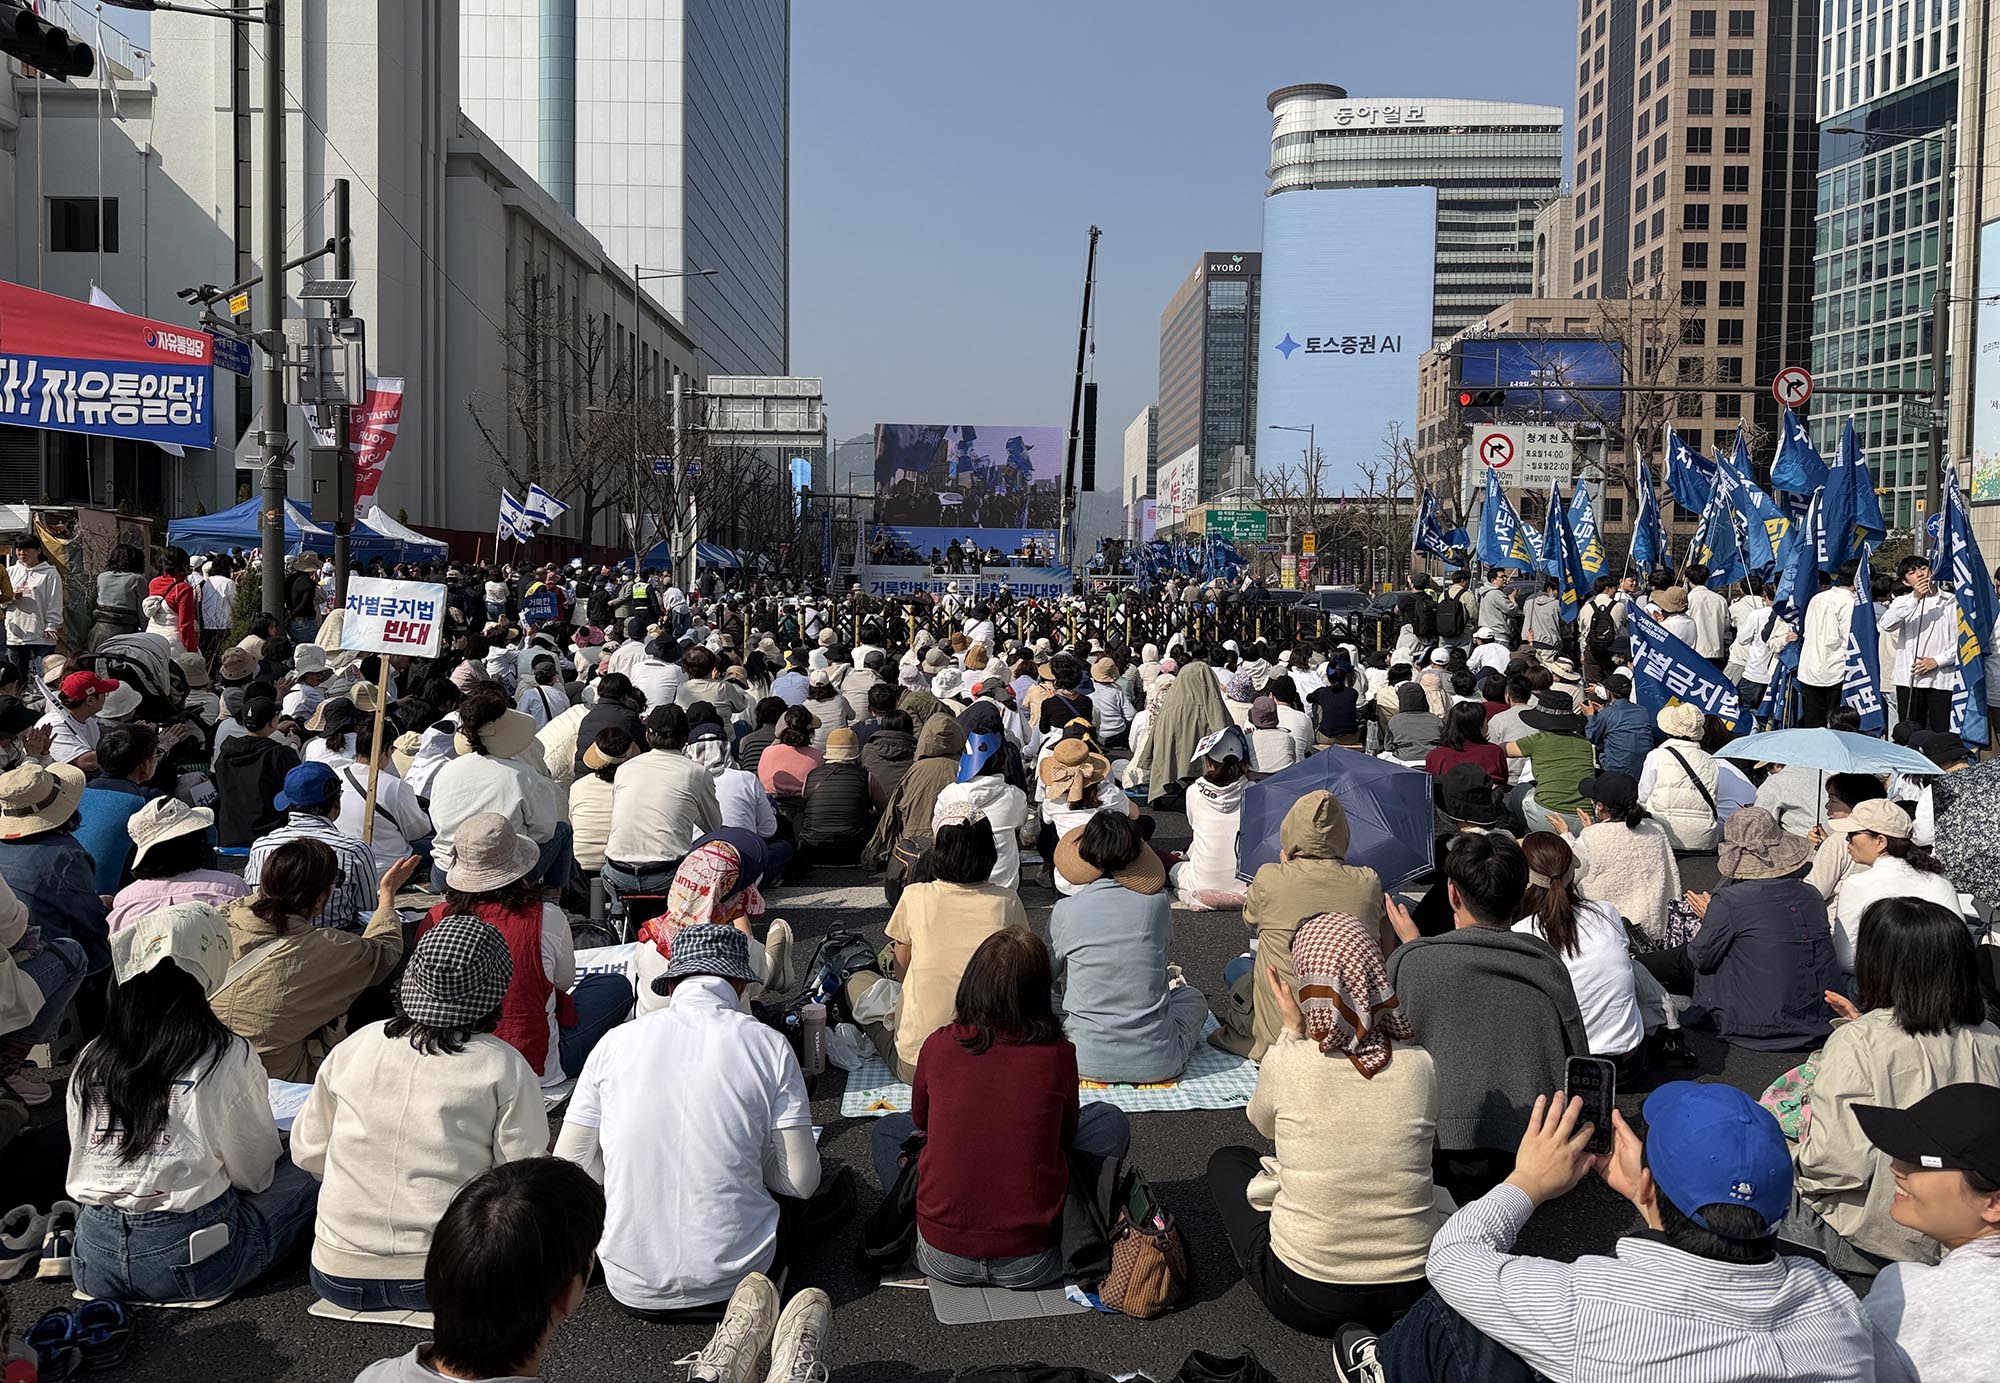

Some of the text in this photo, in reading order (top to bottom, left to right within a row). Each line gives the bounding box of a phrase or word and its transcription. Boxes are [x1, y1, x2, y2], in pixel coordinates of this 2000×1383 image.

[1334, 106, 1426, 125] 동아일보
[1211, 264, 1241, 272] KYOBO
[157, 330, 204, 358] 자유통일당
[1305, 335, 1401, 354] 토스증권 AI
[39, 368, 204, 425] 자유통일당!
[1527, 433, 1570, 444] 청계천로
[346, 594, 435, 621] 차별금지법
[383, 620, 431, 646] 반대
[1630, 634, 1741, 720] 차별금지법
